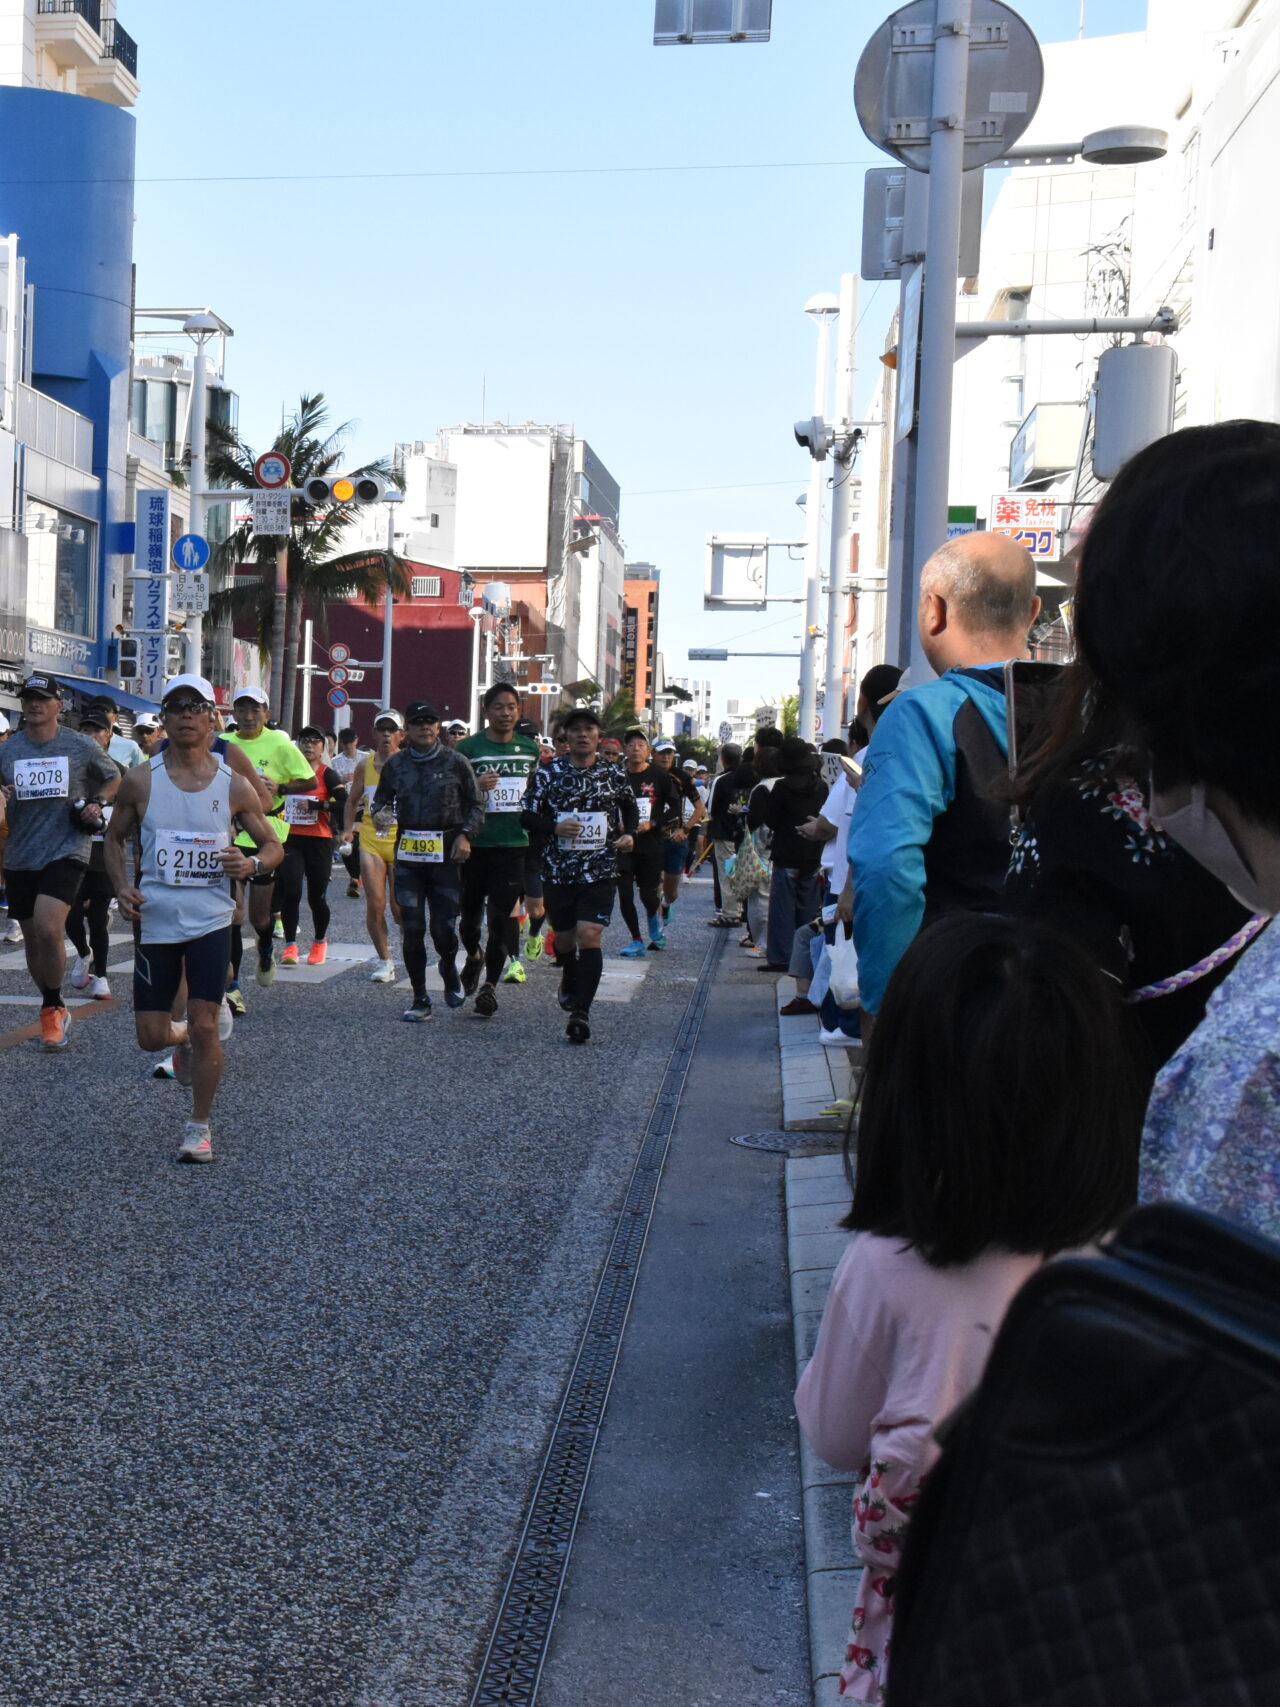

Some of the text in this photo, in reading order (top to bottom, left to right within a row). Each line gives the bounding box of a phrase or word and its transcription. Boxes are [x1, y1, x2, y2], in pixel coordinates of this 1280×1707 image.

[996, 496, 1022, 524] 薬
[1024, 498, 1057, 517] 免税
[175, 583, 185, 592] 12
[196, 583, 205, 592] 18
[15, 769, 63, 787] C 2078
[493, 788, 520, 801] 3871
[412, 839, 435, 853] 493
[156, 848, 220, 870] C 2185
